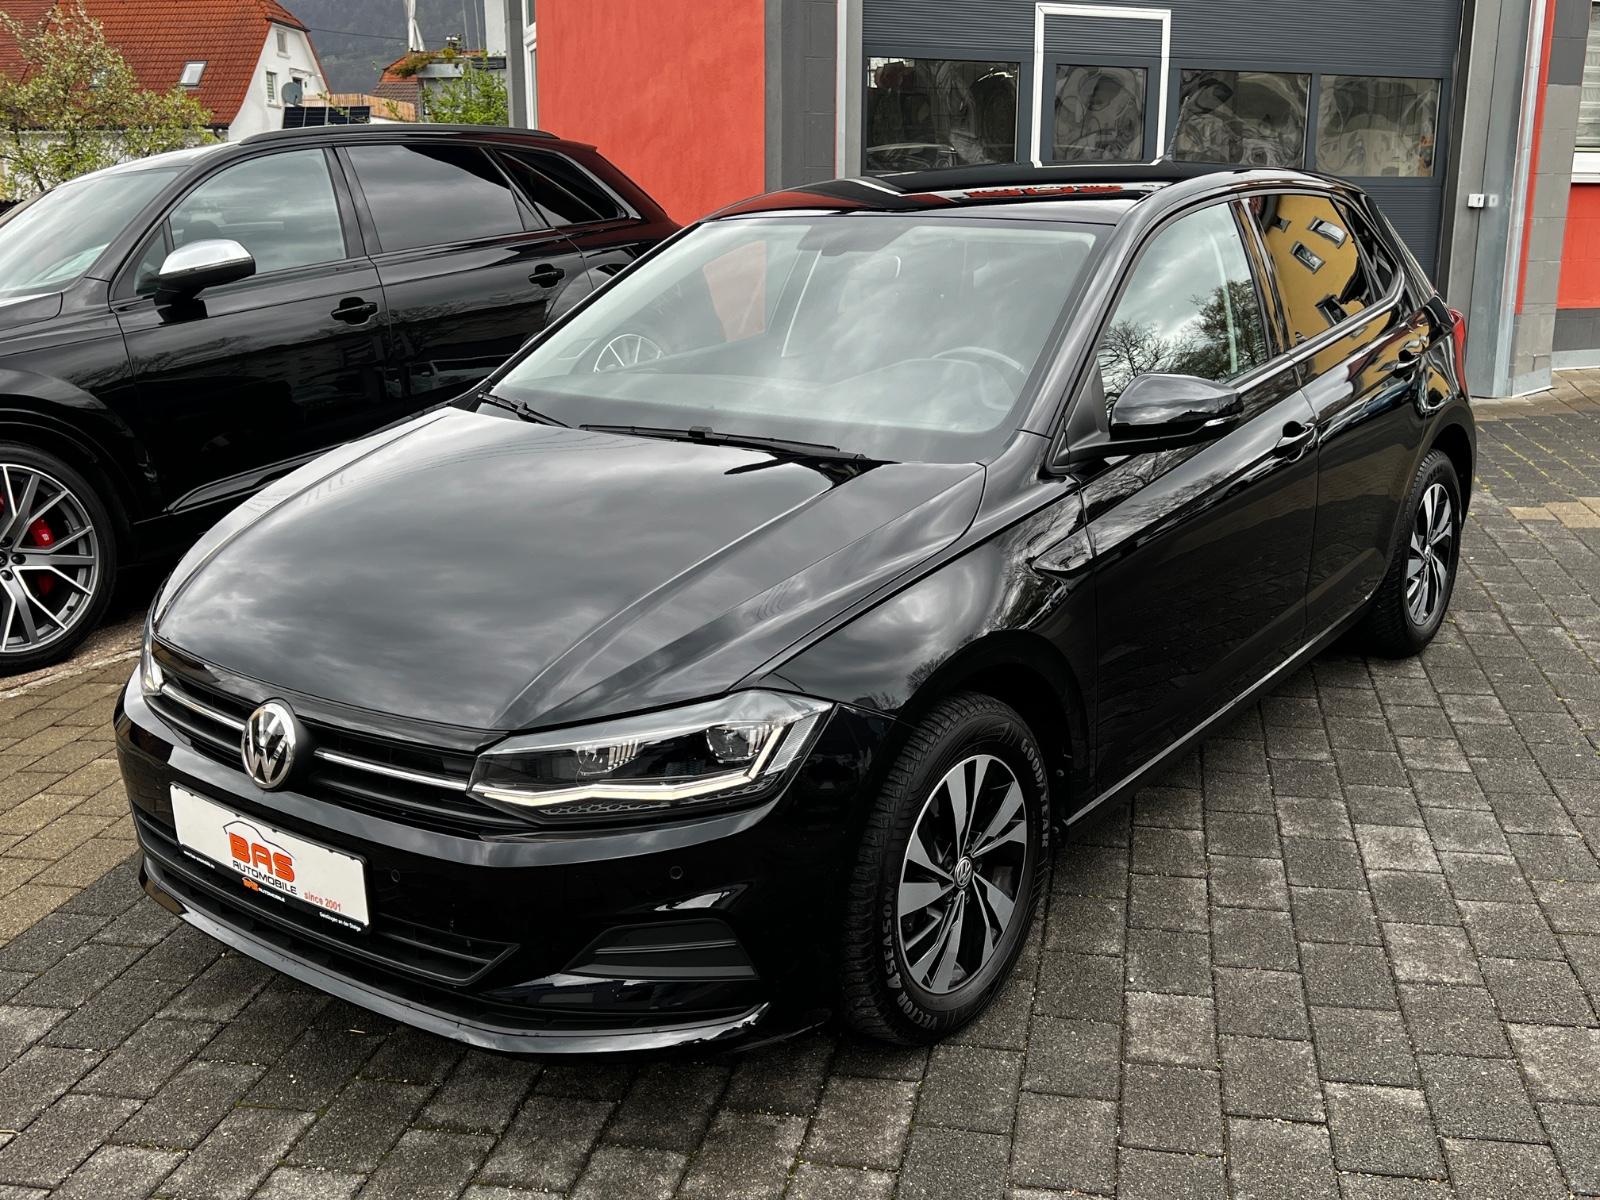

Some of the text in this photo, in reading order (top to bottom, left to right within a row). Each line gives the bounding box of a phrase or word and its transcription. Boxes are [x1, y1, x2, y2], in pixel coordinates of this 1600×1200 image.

[1021, 738, 1049, 849] GOODYEAR
[228, 831, 295, 883] BAS
[232, 859, 297, 896] AUTOMOBILE
[304, 890, 341, 912] since 2001
[896, 990, 939, 1031] VECTOR
